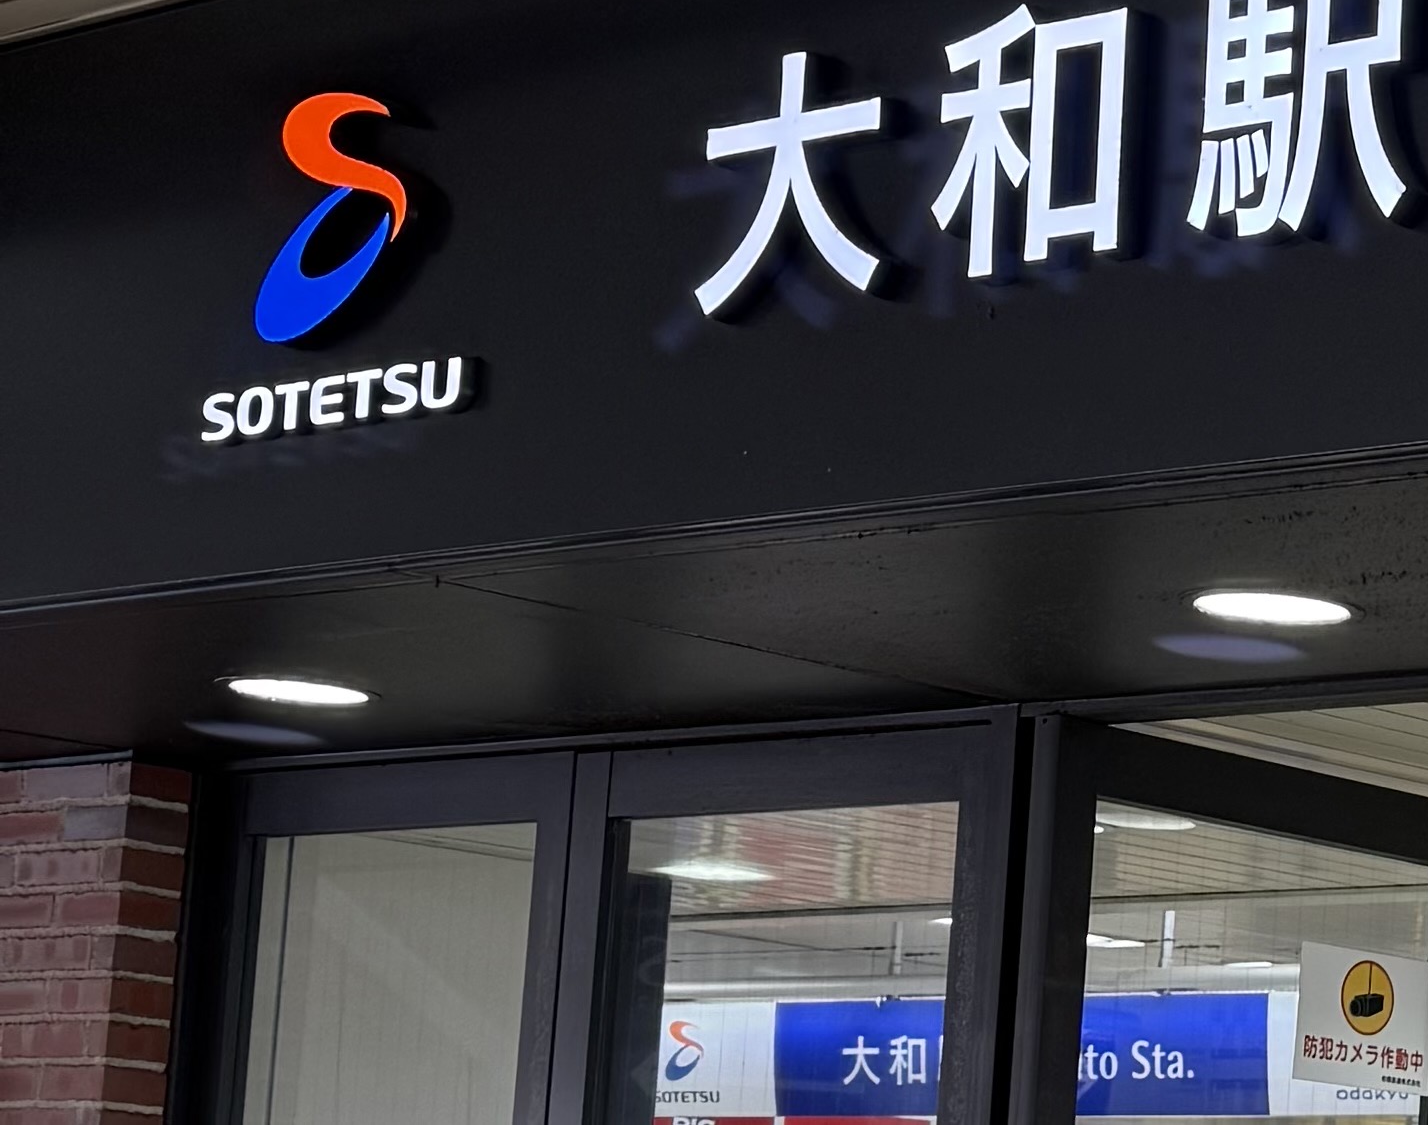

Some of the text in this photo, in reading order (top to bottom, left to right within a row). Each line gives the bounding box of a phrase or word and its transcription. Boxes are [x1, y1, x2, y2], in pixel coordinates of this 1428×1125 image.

[201, 357, 462, 441] SOTETSU
[842, 1035, 944, 1086] 大和
[1131, 1039, 1195, 1080] Sta.
[1303, 1035, 1424, 1072] 防犯カメラ作動中
